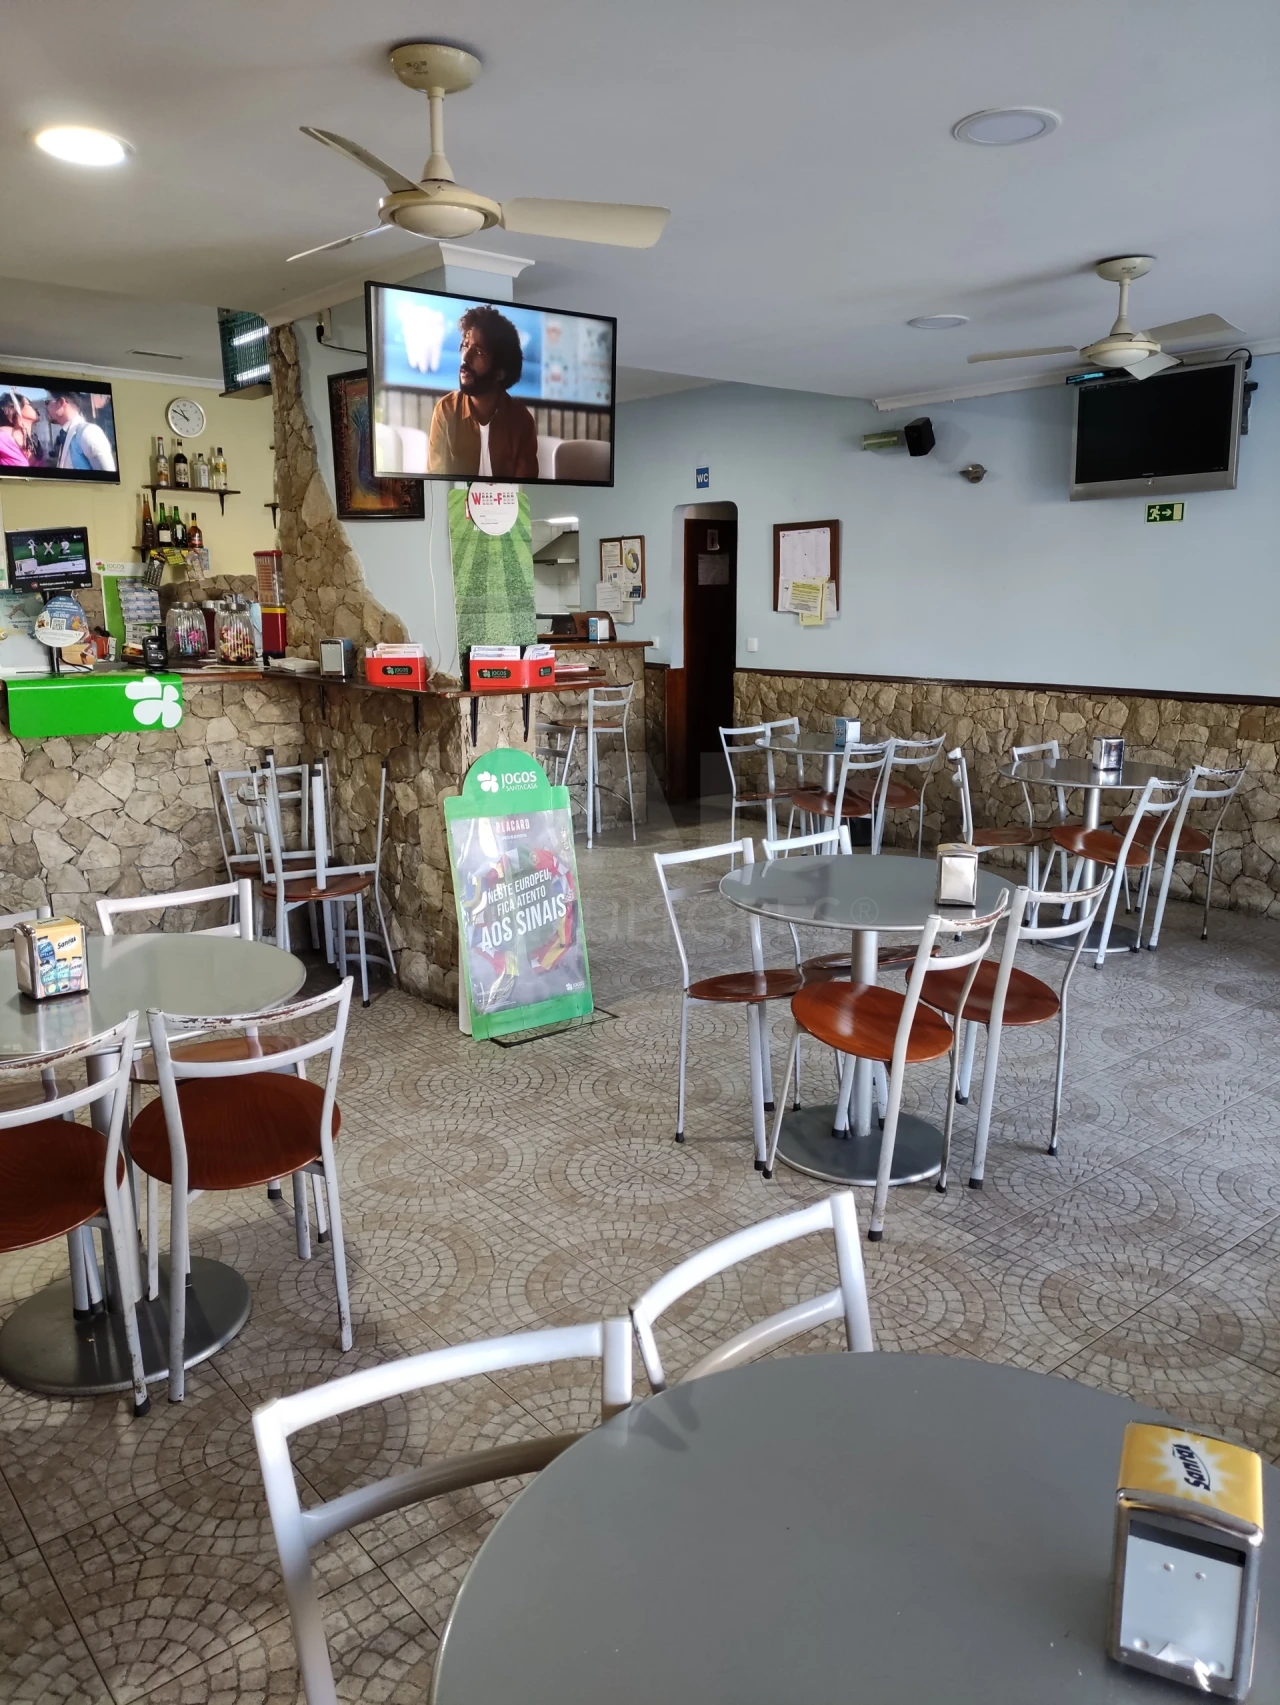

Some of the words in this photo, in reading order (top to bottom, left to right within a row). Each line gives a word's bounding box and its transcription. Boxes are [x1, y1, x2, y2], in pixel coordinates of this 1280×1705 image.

[696, 473, 709, 483] WC
[501, 771, 537, 788] JOGOS
[495, 818, 530, 834] PLACARD
[487, 883, 513, 904] NESTE
[514, 868, 552, 893] EUROPEU,
[496, 900, 515, 917] FICA
[517, 885, 546, 908] ATENTO
[481, 916, 513, 953] AOS
[516, 893, 567, 936] SINAIS
